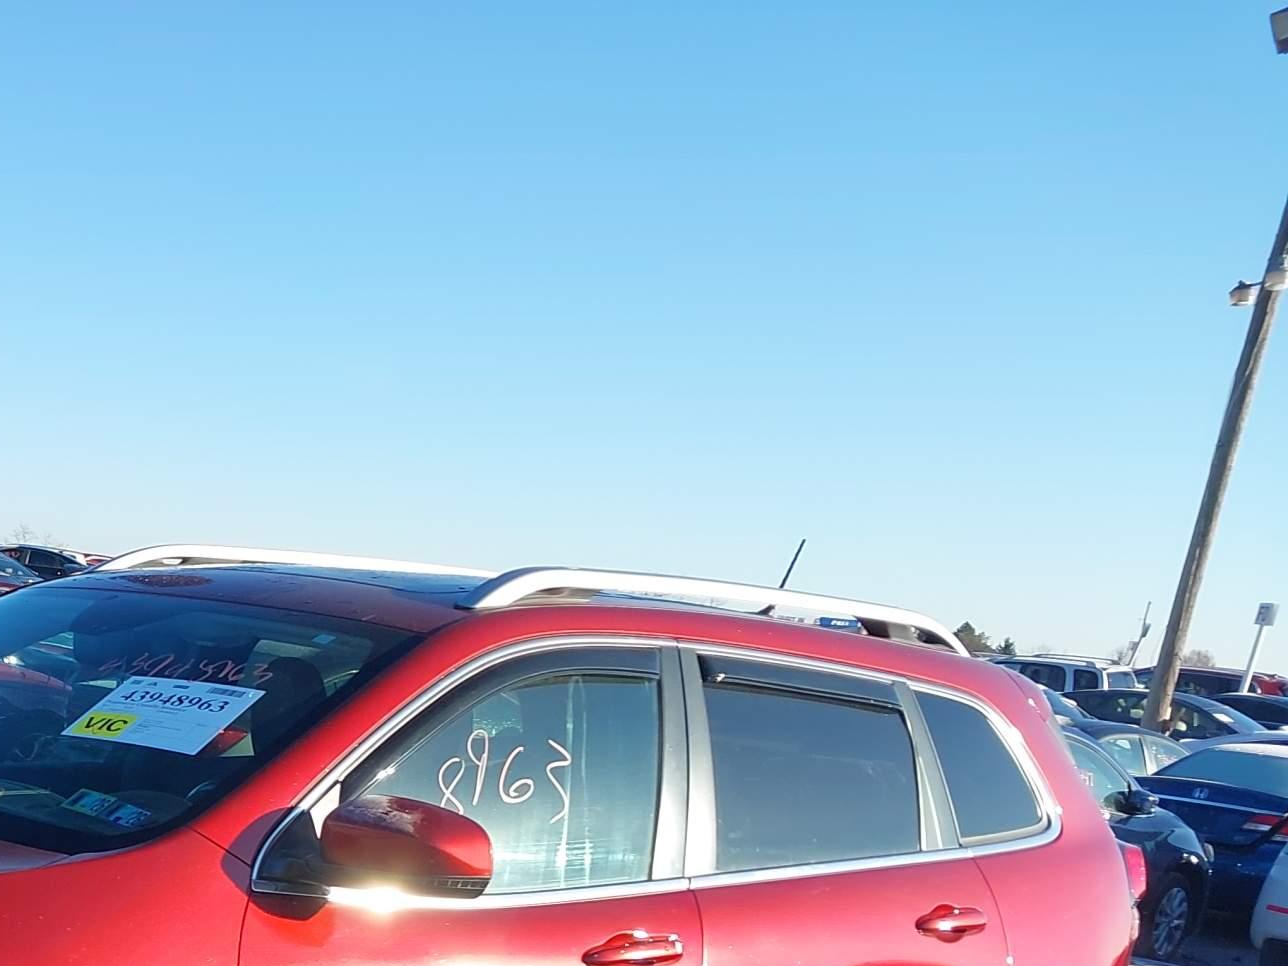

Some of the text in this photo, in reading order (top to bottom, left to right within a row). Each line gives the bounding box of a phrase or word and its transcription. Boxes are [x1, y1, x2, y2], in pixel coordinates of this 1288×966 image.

[121, 689, 231, 713] 43948963
[83, 716, 129, 733] VIC
[438, 729, 572, 825] 8963
